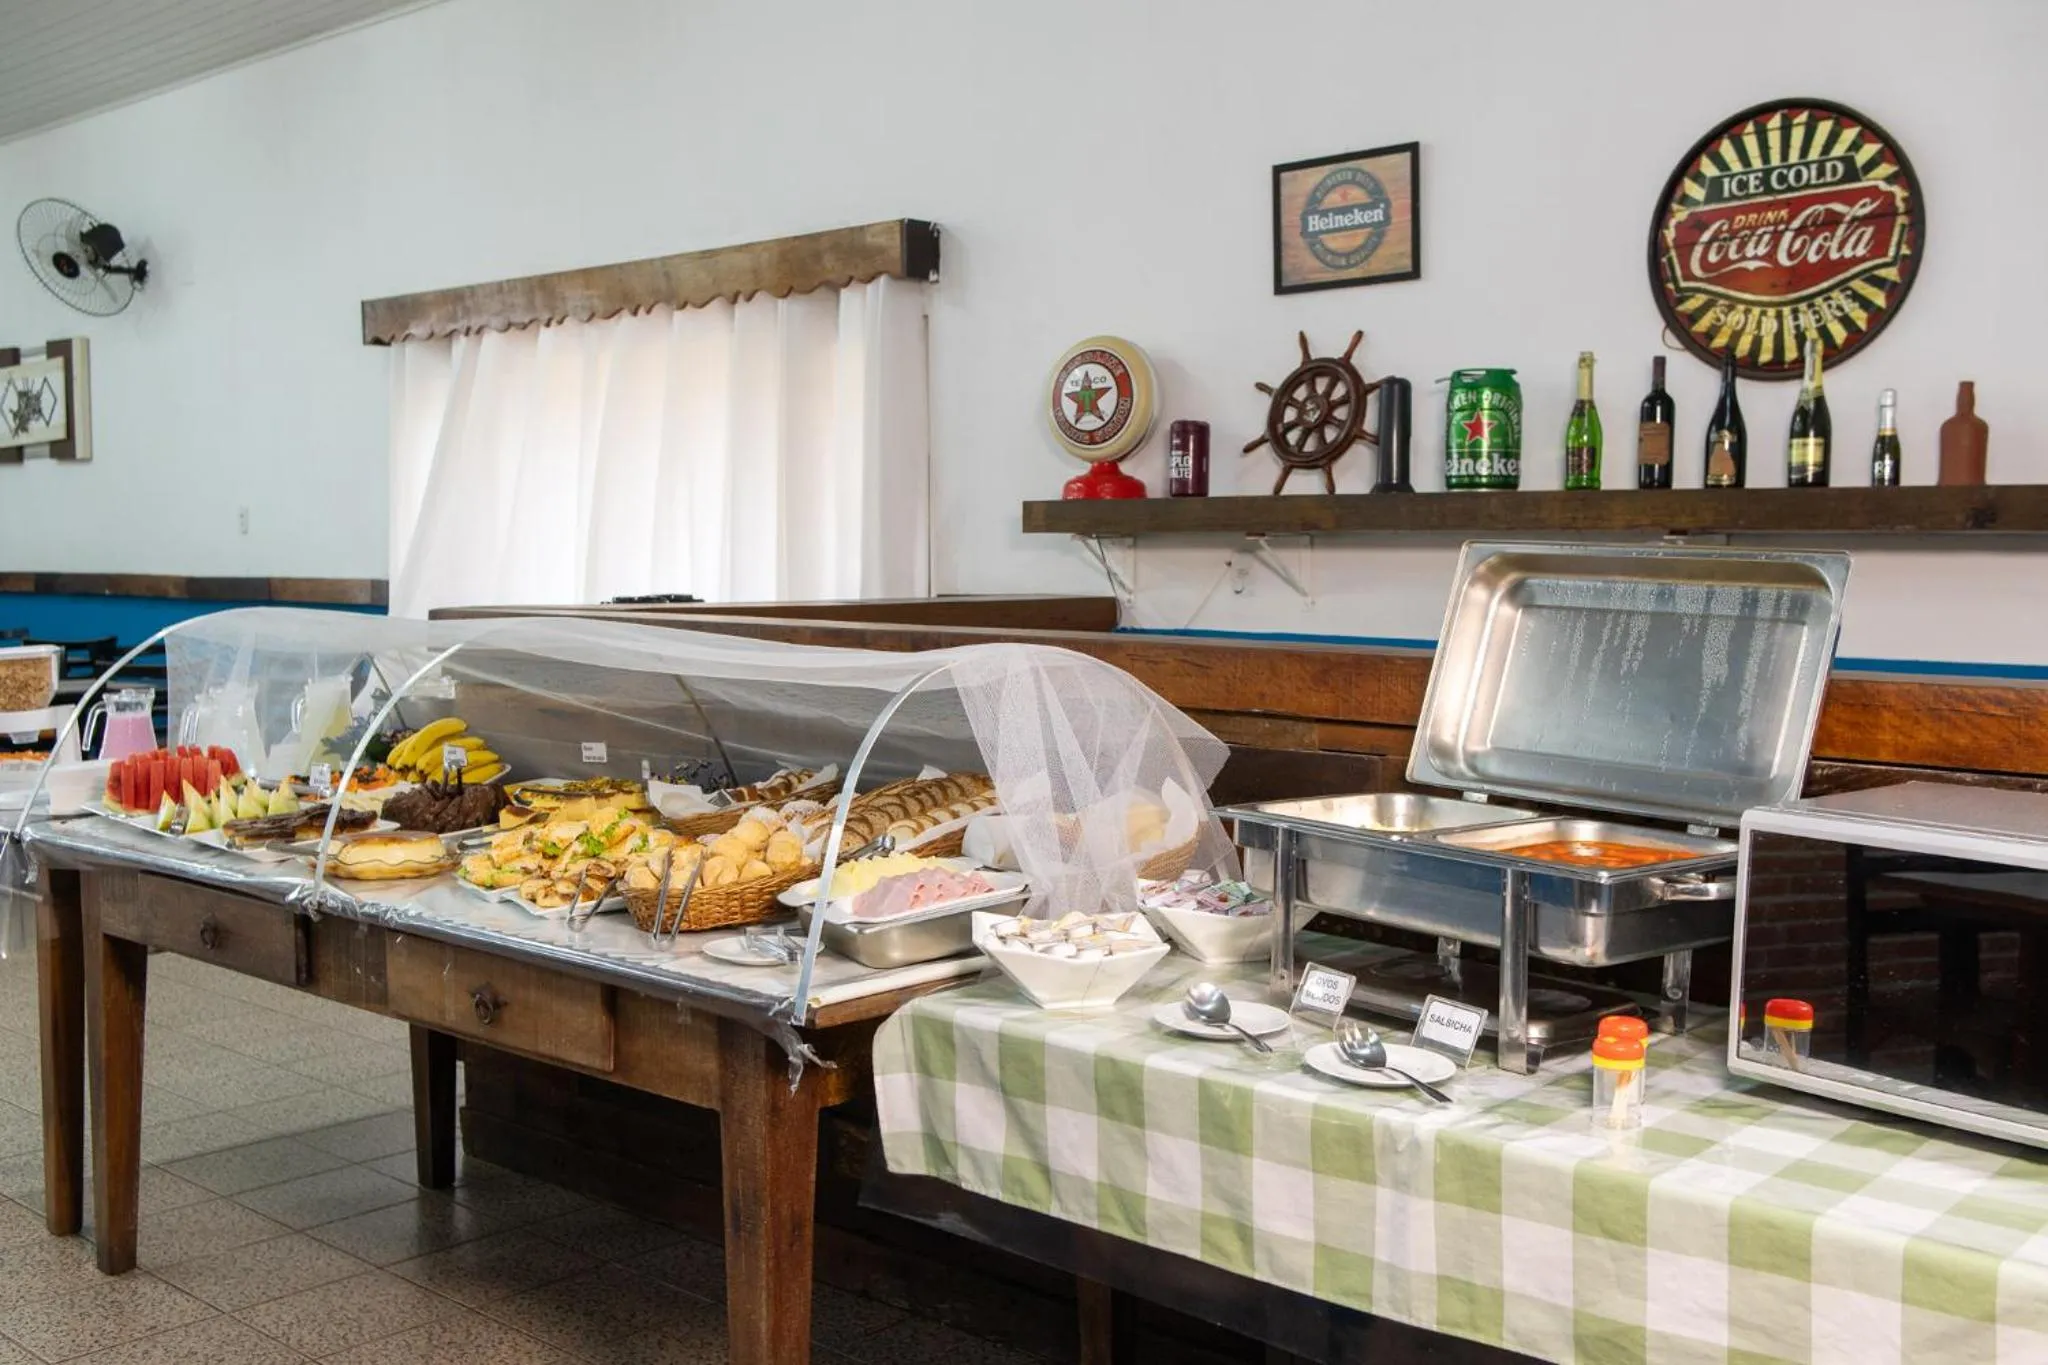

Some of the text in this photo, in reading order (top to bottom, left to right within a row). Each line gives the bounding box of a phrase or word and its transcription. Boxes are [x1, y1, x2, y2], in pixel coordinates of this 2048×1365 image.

[1722, 160, 1845, 199] ICE COLD
[1307, 207, 1385, 232] Heineken
[1733, 207, 1790, 230] DRINK
[1711, 289, 1860, 337] SOLD HERE
[1446, 452, 1521, 477] eineke
[1315, 976, 1339, 990] OVOS
[1429, 1013, 1473, 1034] SALSICHA
